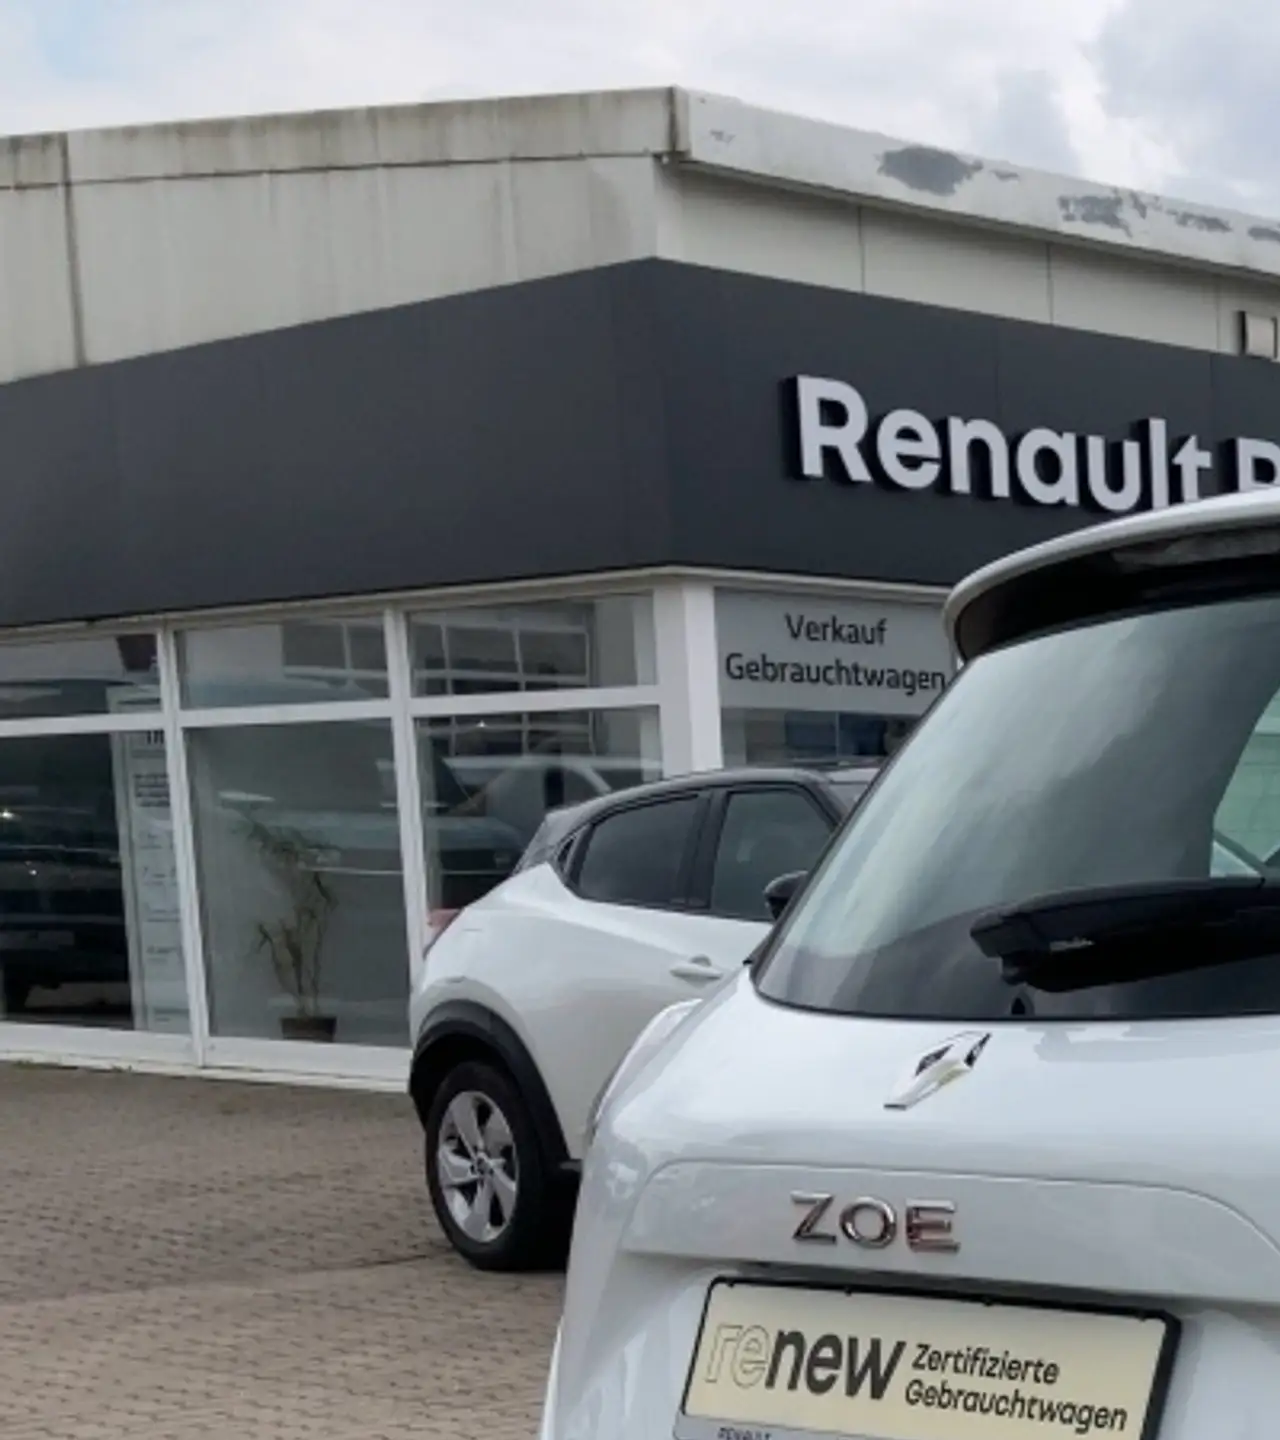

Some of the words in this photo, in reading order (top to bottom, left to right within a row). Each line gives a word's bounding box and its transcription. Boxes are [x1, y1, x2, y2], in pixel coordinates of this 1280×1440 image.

[796, 373, 1212, 511] Renault
[784, 612, 888, 646] Verkauf
[725, 652, 946, 696] Gebrauchtwagen
[789, 1190, 961, 1254] ZOE
[704, 1324, 907, 1401] renew
[911, 1343, 1060, 1385] Zertifizierte
[904, 1378, 1128, 1435] Gebrauchtwagen
